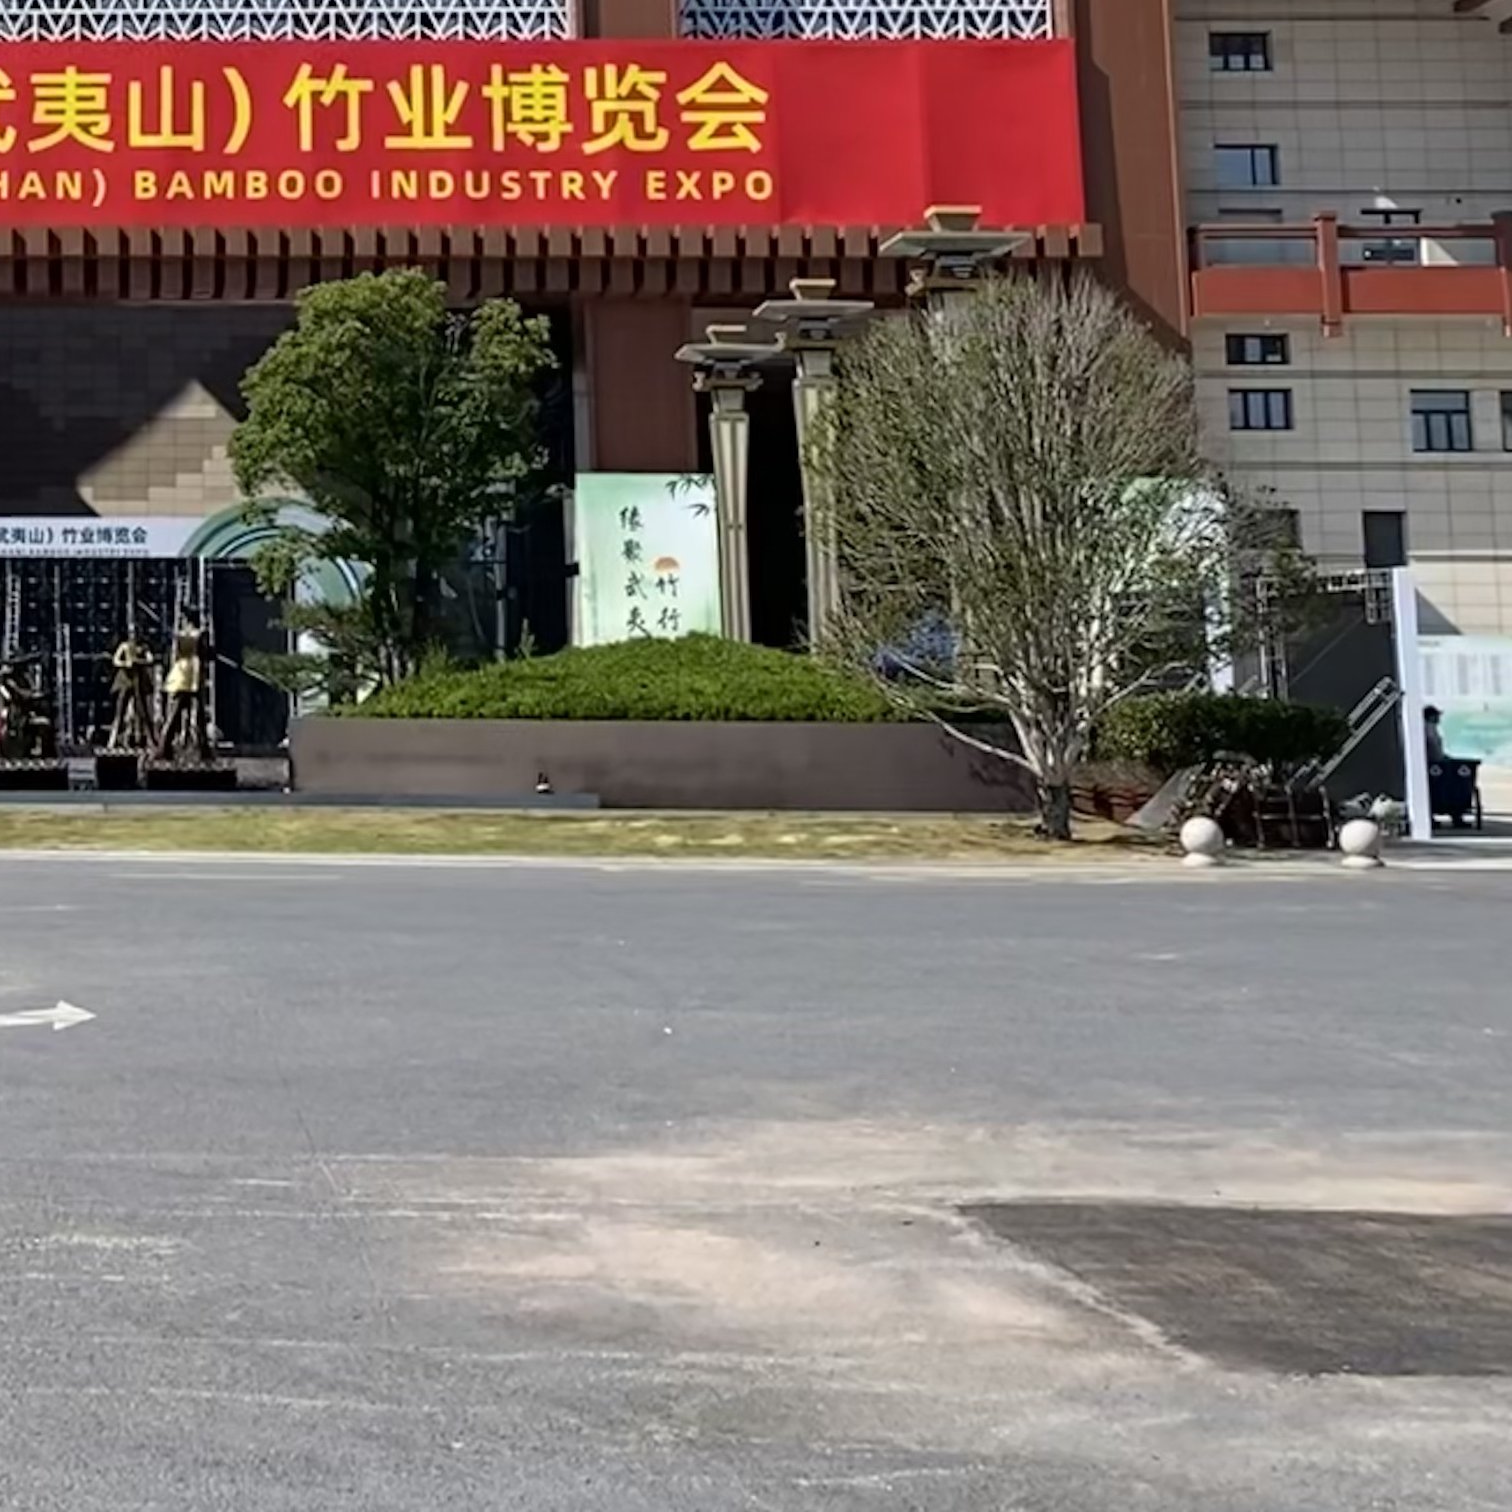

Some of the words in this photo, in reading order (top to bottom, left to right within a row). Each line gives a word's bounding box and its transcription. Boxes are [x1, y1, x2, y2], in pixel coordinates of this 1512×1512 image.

[135, 170, 342, 199] BAMBOO
[372, 170, 618, 199] INDUSTRY
[647, 171, 772, 200] EXPO
